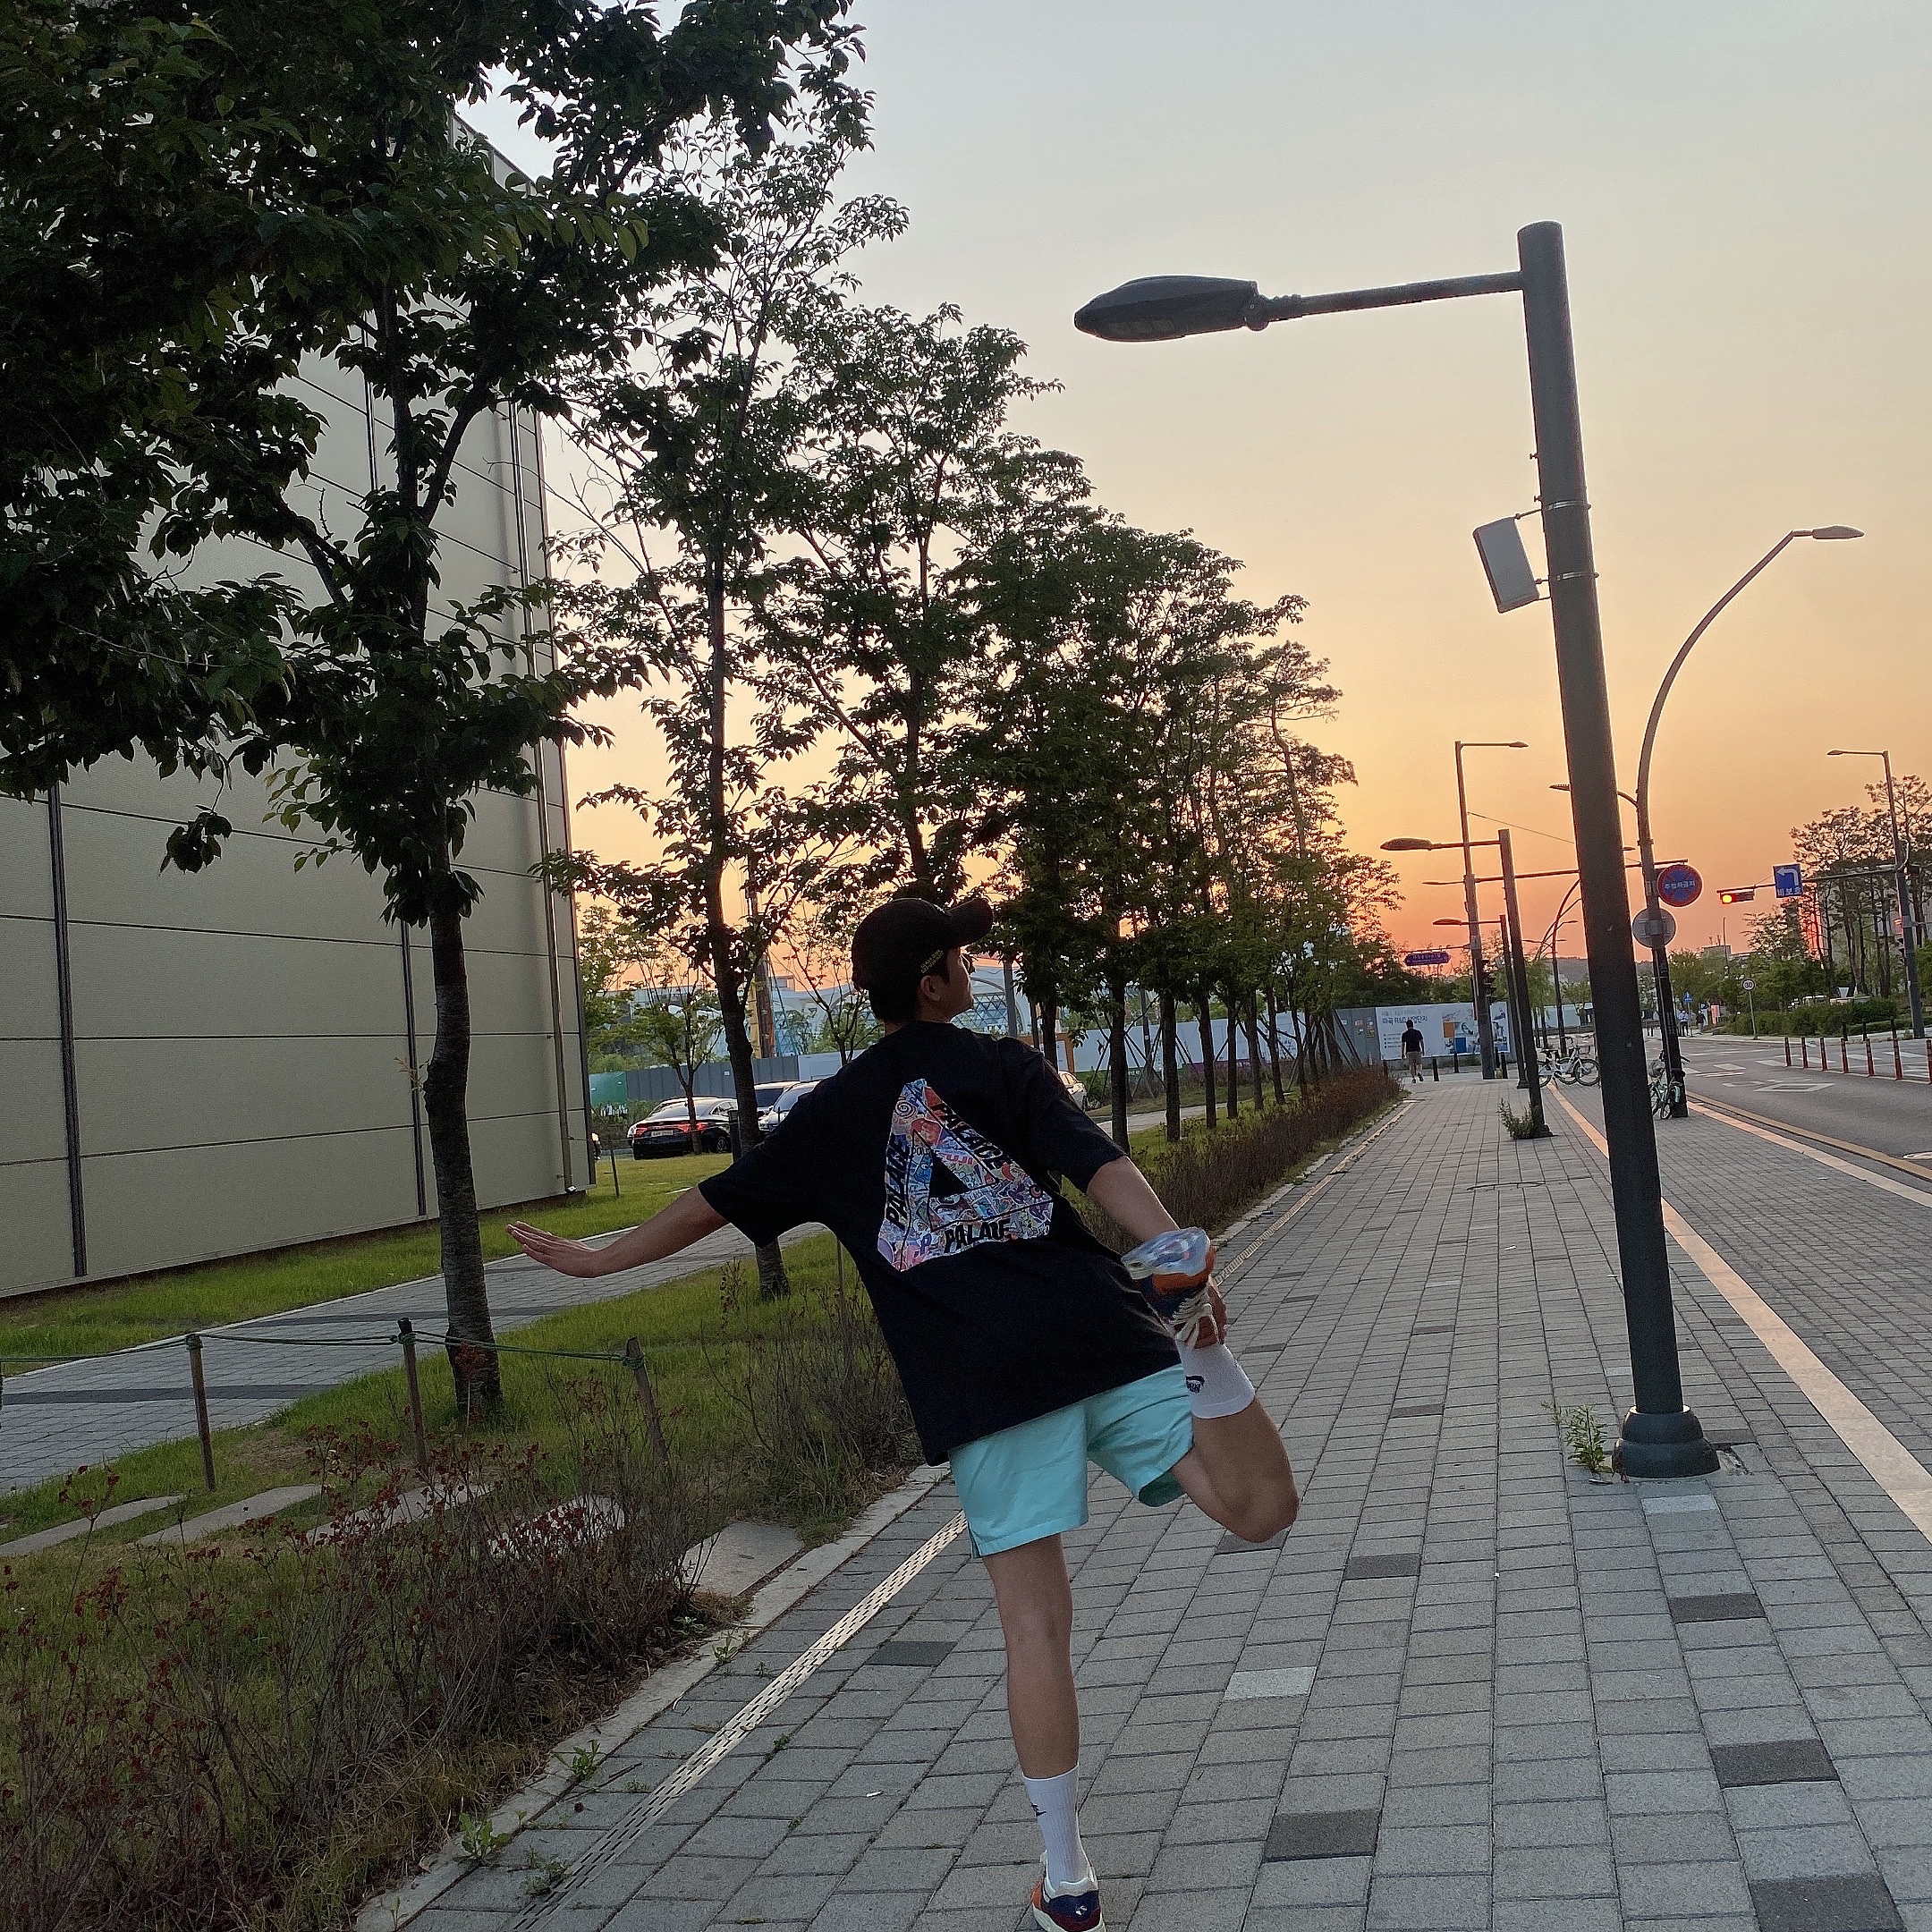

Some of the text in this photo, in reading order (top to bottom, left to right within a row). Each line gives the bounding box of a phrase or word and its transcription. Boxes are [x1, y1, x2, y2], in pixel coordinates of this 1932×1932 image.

[1777, 886, 1802, 896] 비보호
[886, 1134, 910, 1232] PALACE
[945, 1218, 1011, 1254] PALACE
